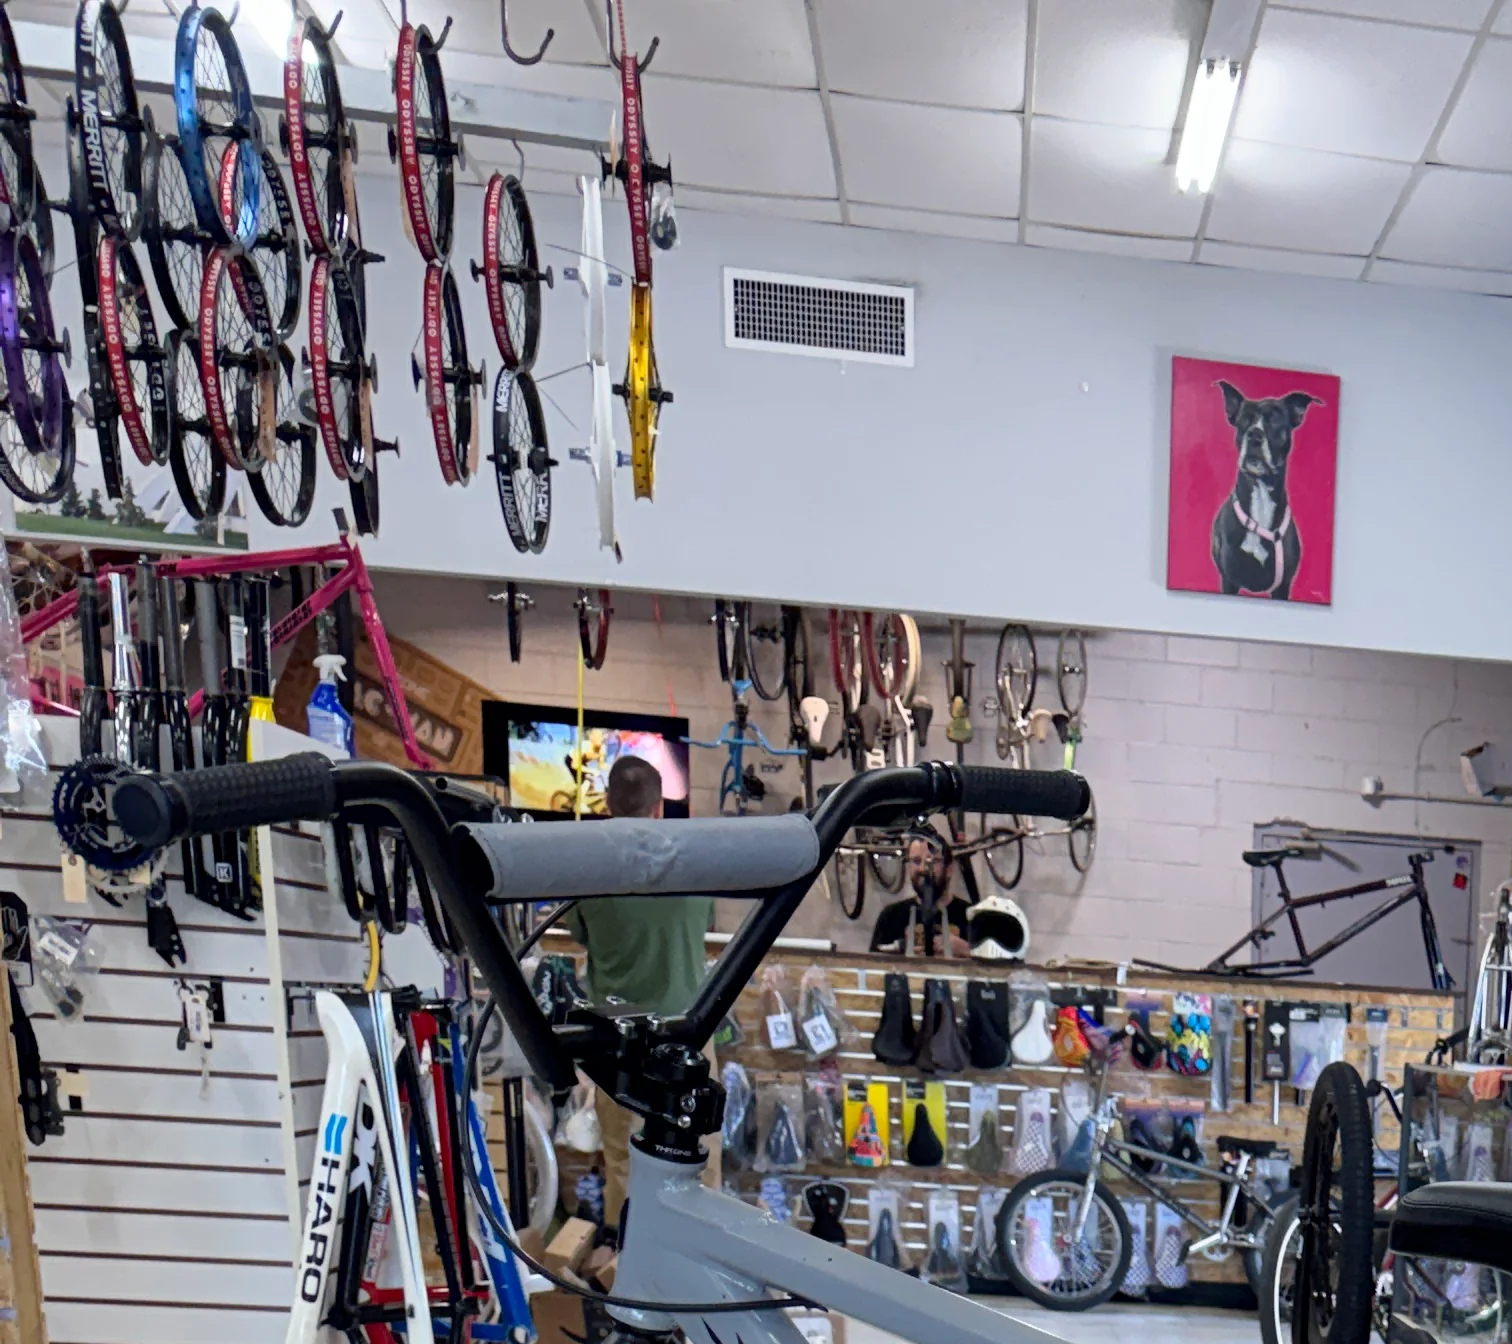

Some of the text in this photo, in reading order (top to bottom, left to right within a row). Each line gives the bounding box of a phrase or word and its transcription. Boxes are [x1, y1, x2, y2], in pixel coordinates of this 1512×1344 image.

[80, 89, 109, 191] MERRITT
[288, 97, 304, 163] ODYSSEY
[401, 100, 416, 165] ODYSSEY
[626, 97, 639, 154] ODYSSEY
[101, 285, 118, 344] ODYSSEY
[202, 307, 214, 367] ODYSSEY
[313, 290, 324, 345] ODYSSEY
[428, 288, 440, 338] ODYSSEY
[110, 353, 132, 413] ODYSSEY
[313, 355, 330, 415] ODYSSEY
[428, 346, 445, 406] ODYSSEY
[498, 471, 522, 538] MERRITT
[301, 1156, 340, 1304] HARO
